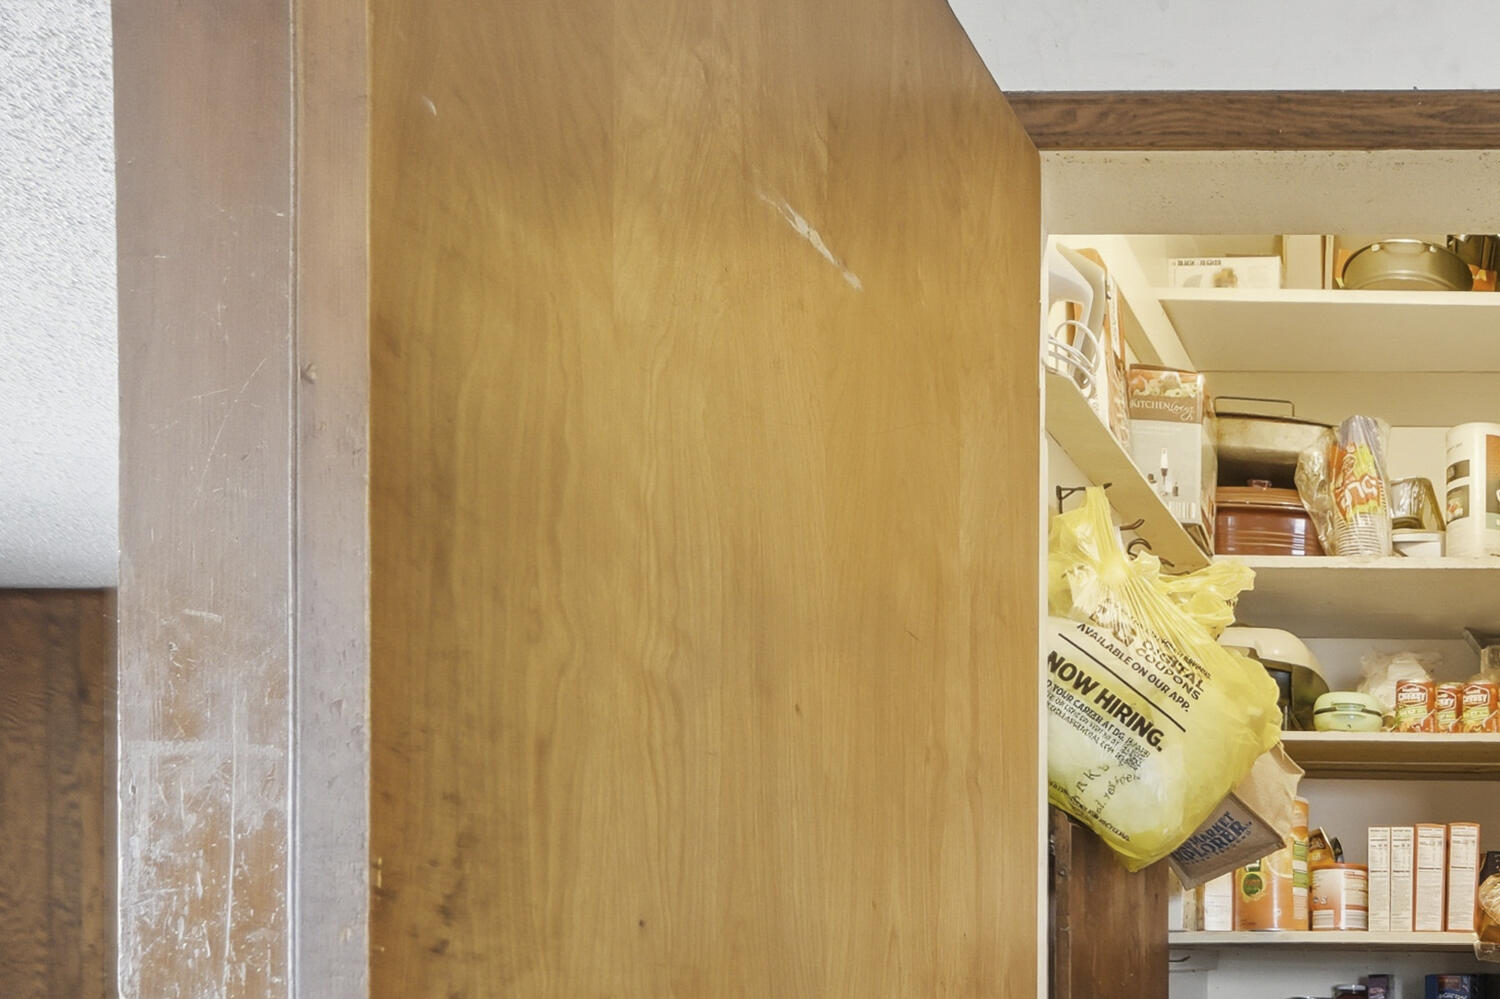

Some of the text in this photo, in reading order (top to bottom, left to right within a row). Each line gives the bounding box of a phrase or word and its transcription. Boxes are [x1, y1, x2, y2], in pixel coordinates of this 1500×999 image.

[1048, 650, 1099, 696] NOW
[1093, 687, 1165, 752] HIRING.
[1076, 623, 1191, 712] AVAILABLE ON OUR APP.
